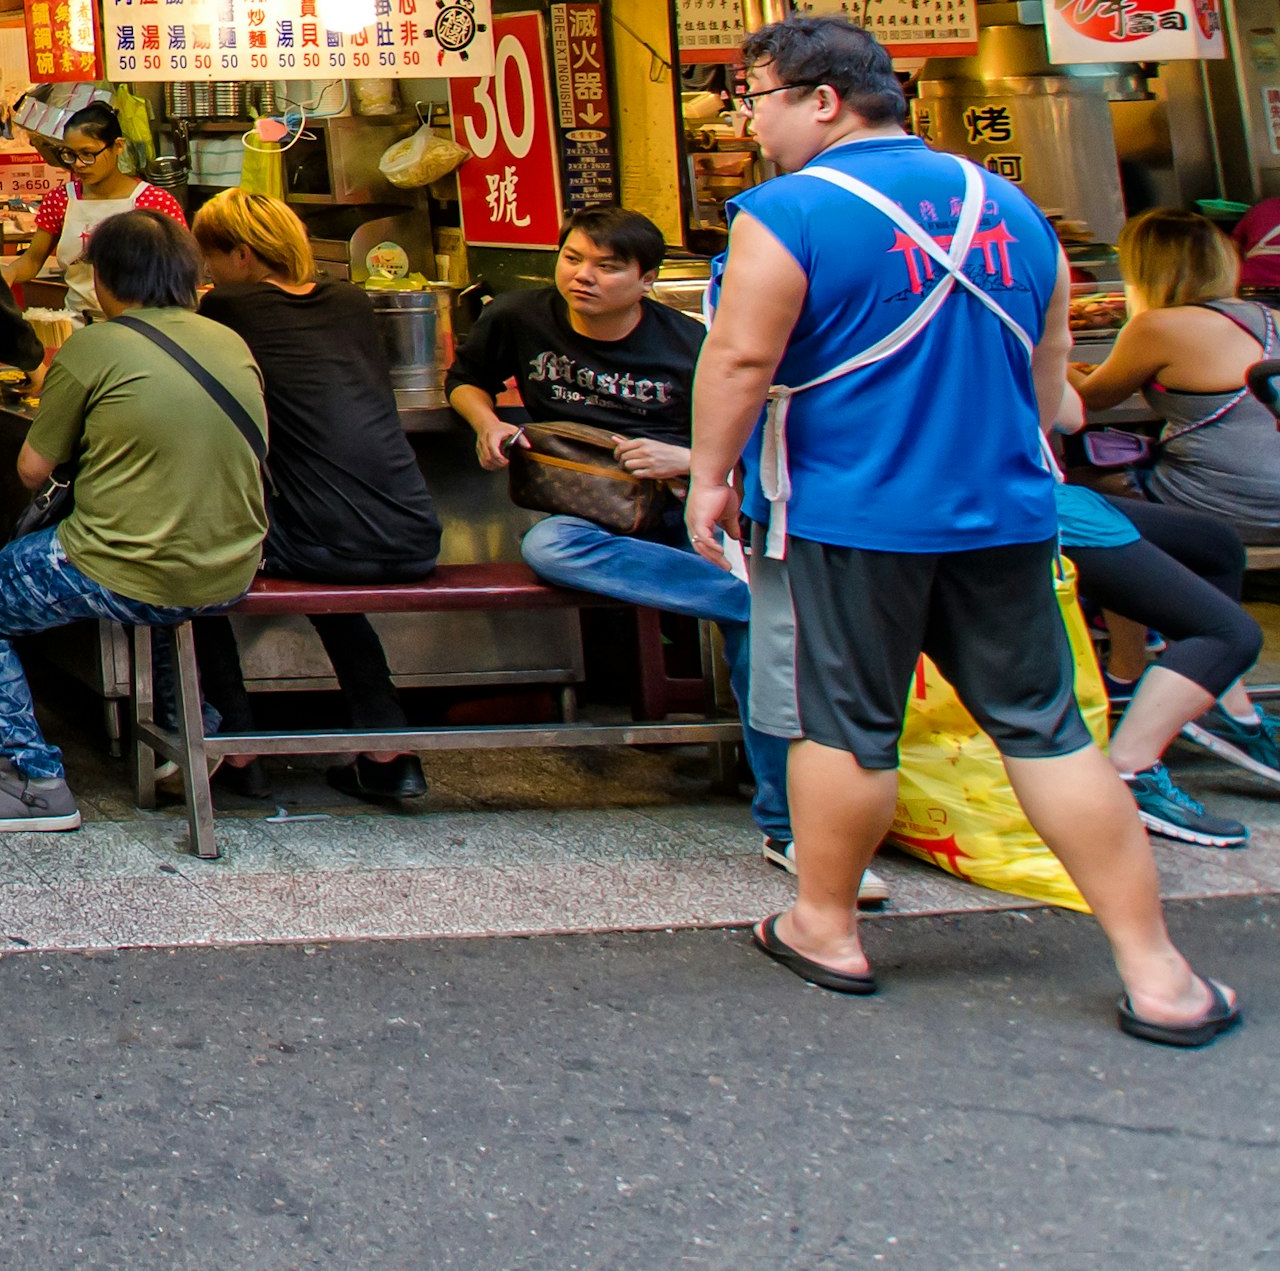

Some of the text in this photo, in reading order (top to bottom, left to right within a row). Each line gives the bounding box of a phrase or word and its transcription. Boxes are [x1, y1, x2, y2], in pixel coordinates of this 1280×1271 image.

[194, 54, 212, 69] 50
[221, 54, 238, 68] 50
[251, 54, 268, 68] 50
[278, 54, 295, 68] 50
[303, 53, 320, 67] 50
[329, 53, 346, 67] 50
[353, 53, 370, 66] 50
[379, 52, 396, 66] 50
[403, 51, 420, 65] 50
[569, 8, 603, 101] 滅火器
[119, 56, 136, 70] 50
[144, 55, 161, 69] 50
[170, 55, 187, 69] 50
[965, 107, 1011, 142] 烤
[485, 166, 531, 227] 號
